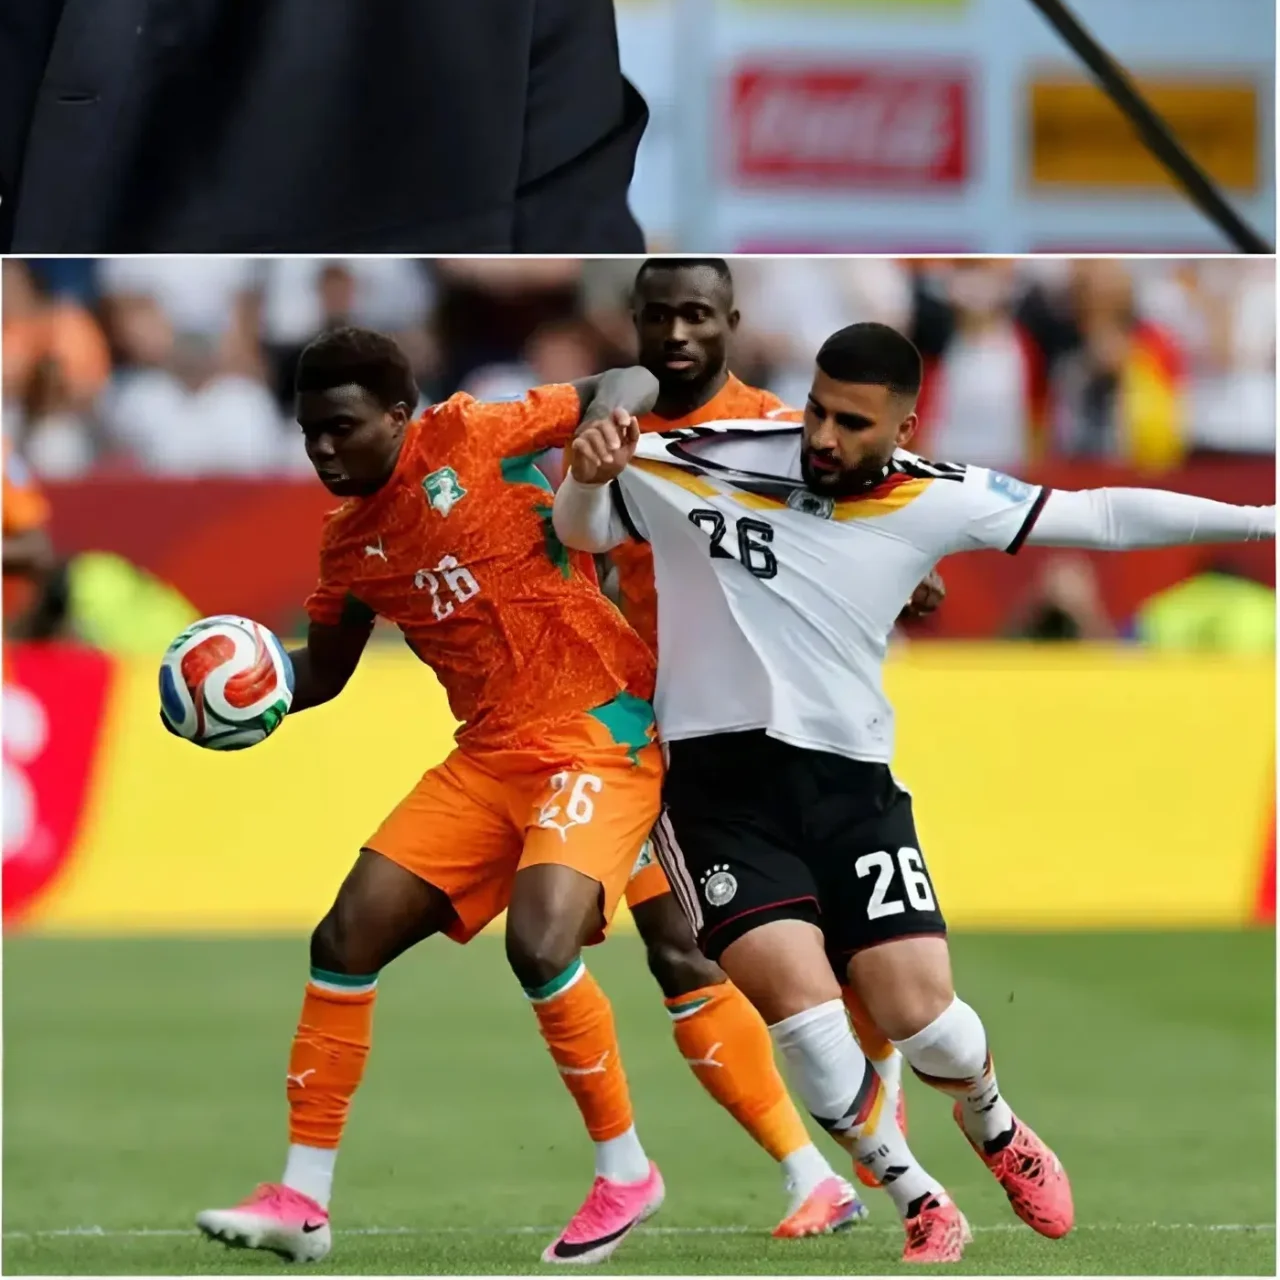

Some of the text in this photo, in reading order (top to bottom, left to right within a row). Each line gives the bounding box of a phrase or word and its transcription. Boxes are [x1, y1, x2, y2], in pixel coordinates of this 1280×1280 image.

[688, 508, 778, 580] 26
[414, 554, 481, 621] 26
[538, 770, 603, 826] 26
[854, 846, 936, 921] 26
